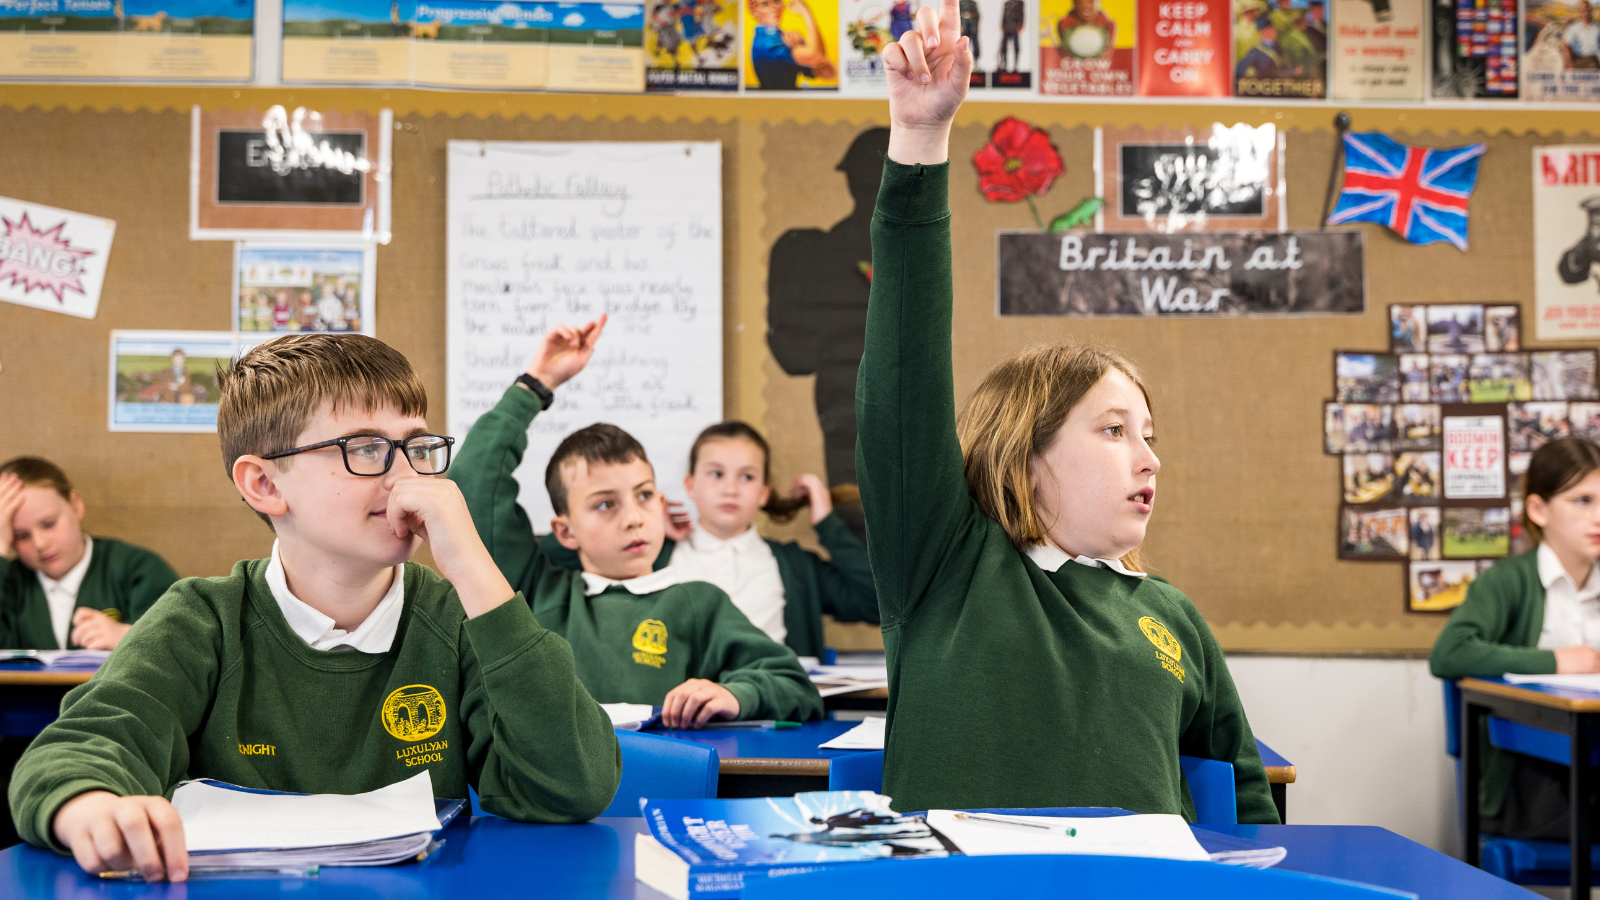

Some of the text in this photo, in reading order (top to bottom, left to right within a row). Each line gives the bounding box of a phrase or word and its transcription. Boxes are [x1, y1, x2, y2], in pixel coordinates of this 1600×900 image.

[1159, 2, 1209, 19] KEEP
[1155, 20, 1212, 37] CALM
[1154, 48, 1214, 65] CARRY
[1169, 66, 1200, 84] ON
[1237, 78, 1323, 96] TOGETHER
[564, 170, 629, 219] Fallacy
[1059, 235, 1304, 271] Britain at
[1140, 275, 1231, 312] War
[1446, 448, 1499, 471] KEEP
[396, 740, 449, 760] LUXULYAN
[405, 752, 444, 767] SCHOOL
